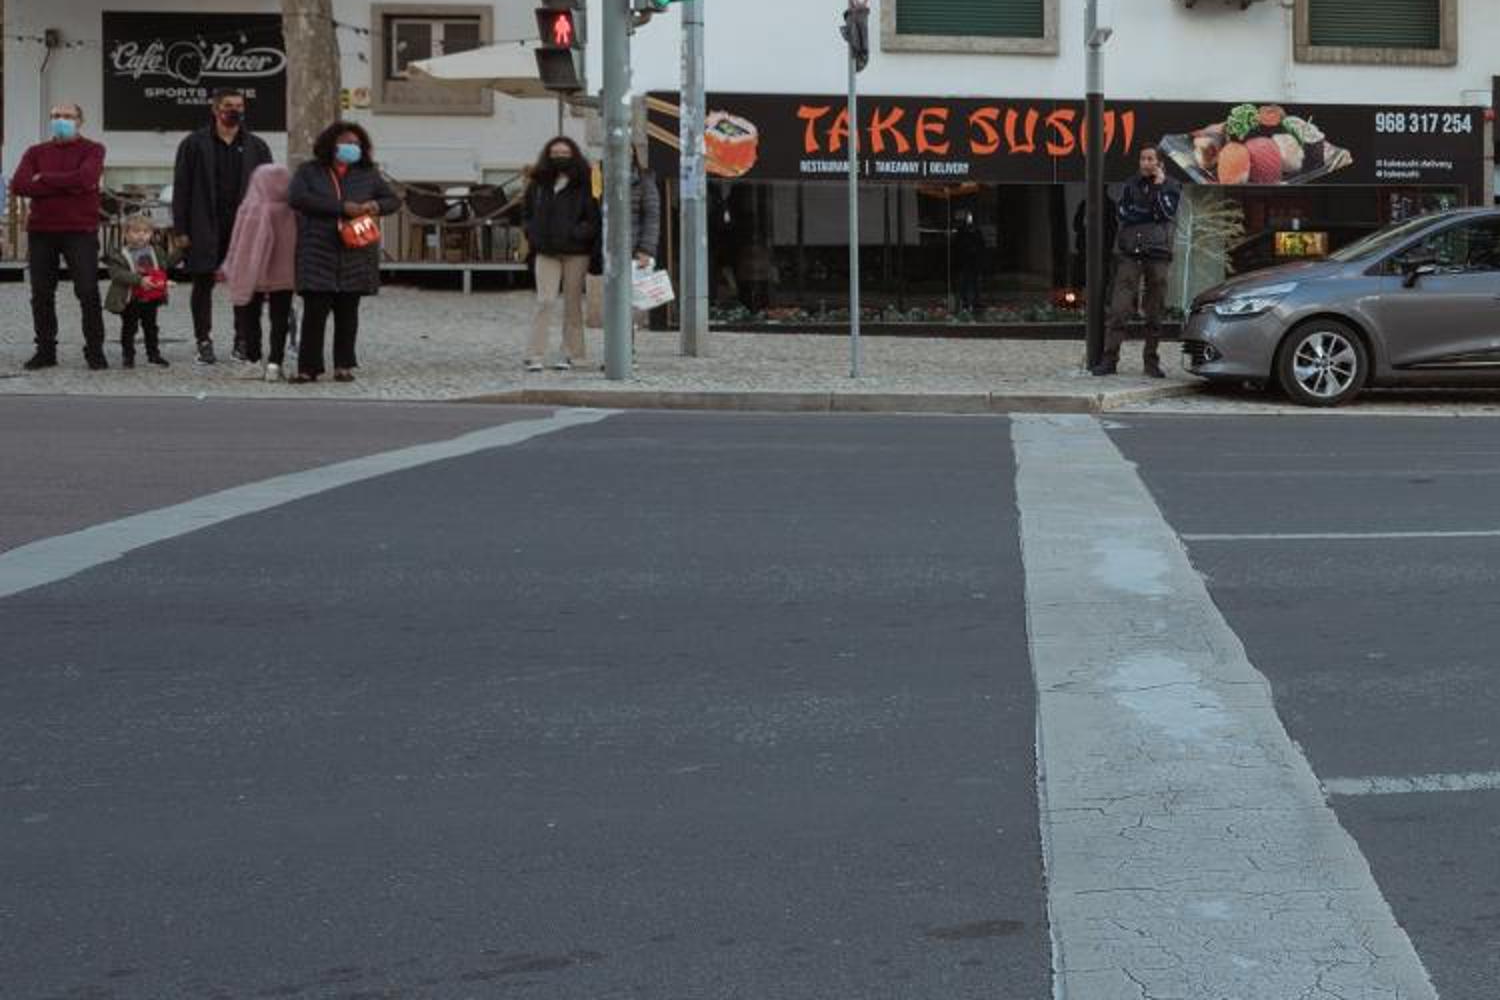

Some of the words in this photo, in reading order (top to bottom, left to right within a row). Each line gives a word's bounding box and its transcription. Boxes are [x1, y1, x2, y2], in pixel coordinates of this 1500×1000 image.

[205, 43, 273, 71] Racer
[144, 88, 206, 98] SPORTS
[797, 106, 951, 153] TAKE
[968, 107, 1135, 155] SUSHI
[1376, 112, 1405, 133] 968
[1409, 113, 1439, 133] 317
[1442, 113, 1472, 134] 254
[875, 161, 919, 173] TAKEAWAY
[930, 162, 969, 175] DELIVERY
